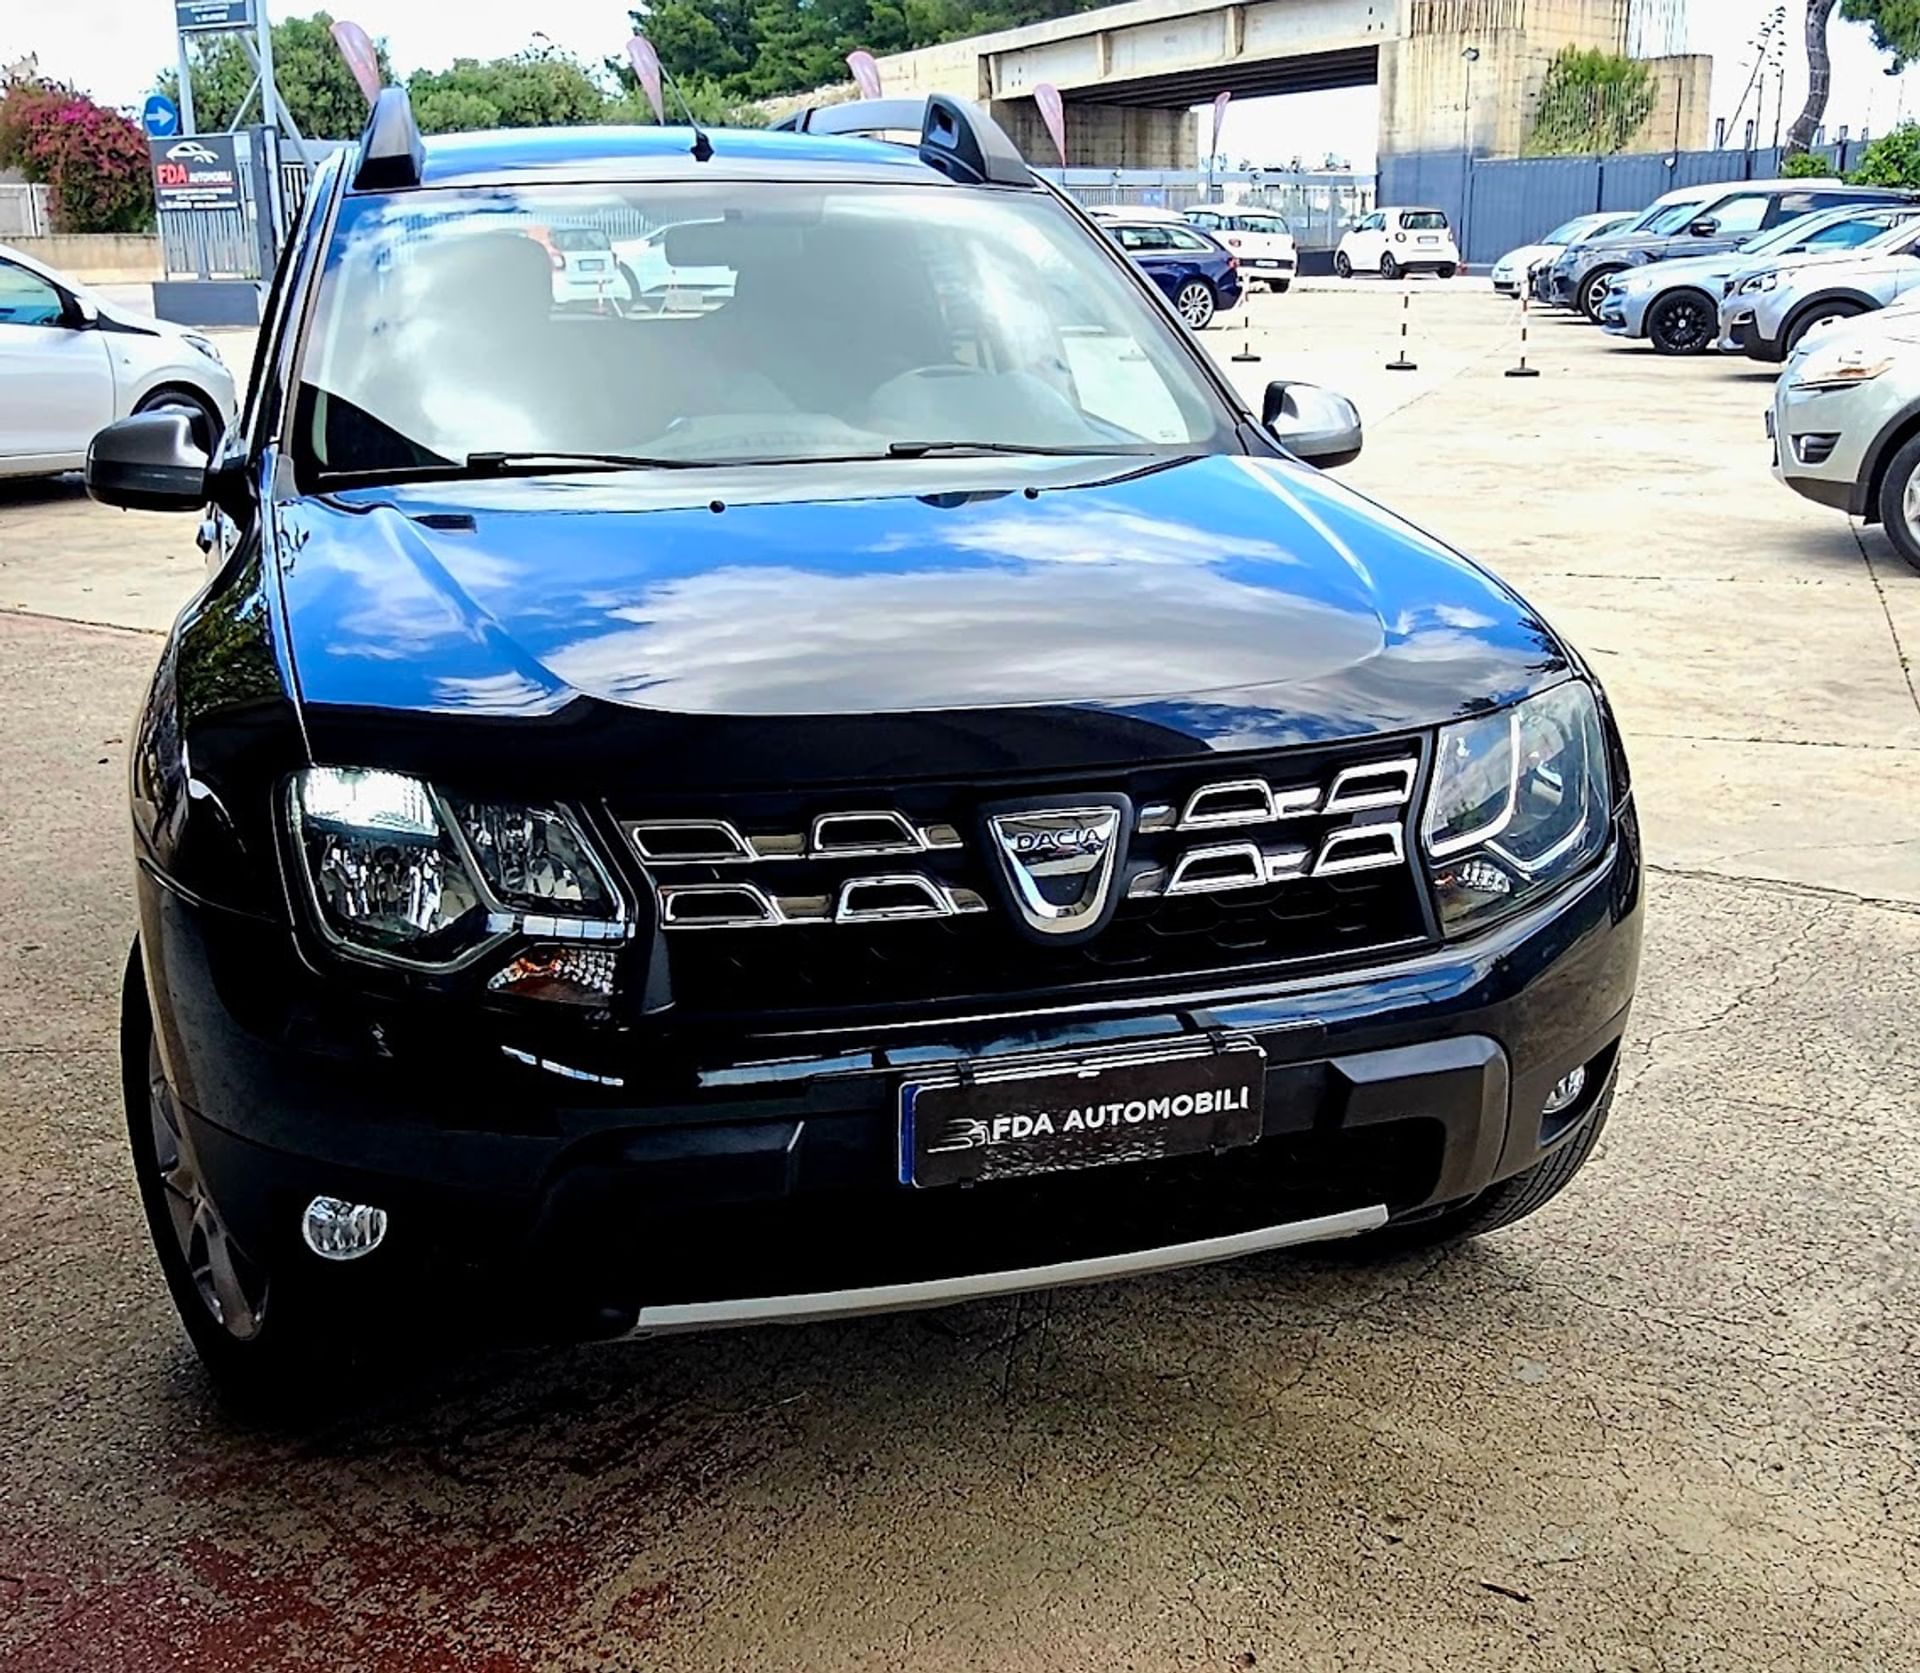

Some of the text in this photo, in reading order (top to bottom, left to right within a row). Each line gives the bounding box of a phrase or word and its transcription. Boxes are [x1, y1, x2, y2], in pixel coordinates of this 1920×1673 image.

[157, 163, 188, 184] FDA
[1016, 828, 1103, 851] DACIA
[992, 1086, 1249, 1140] FDA AUTOMOBILI
